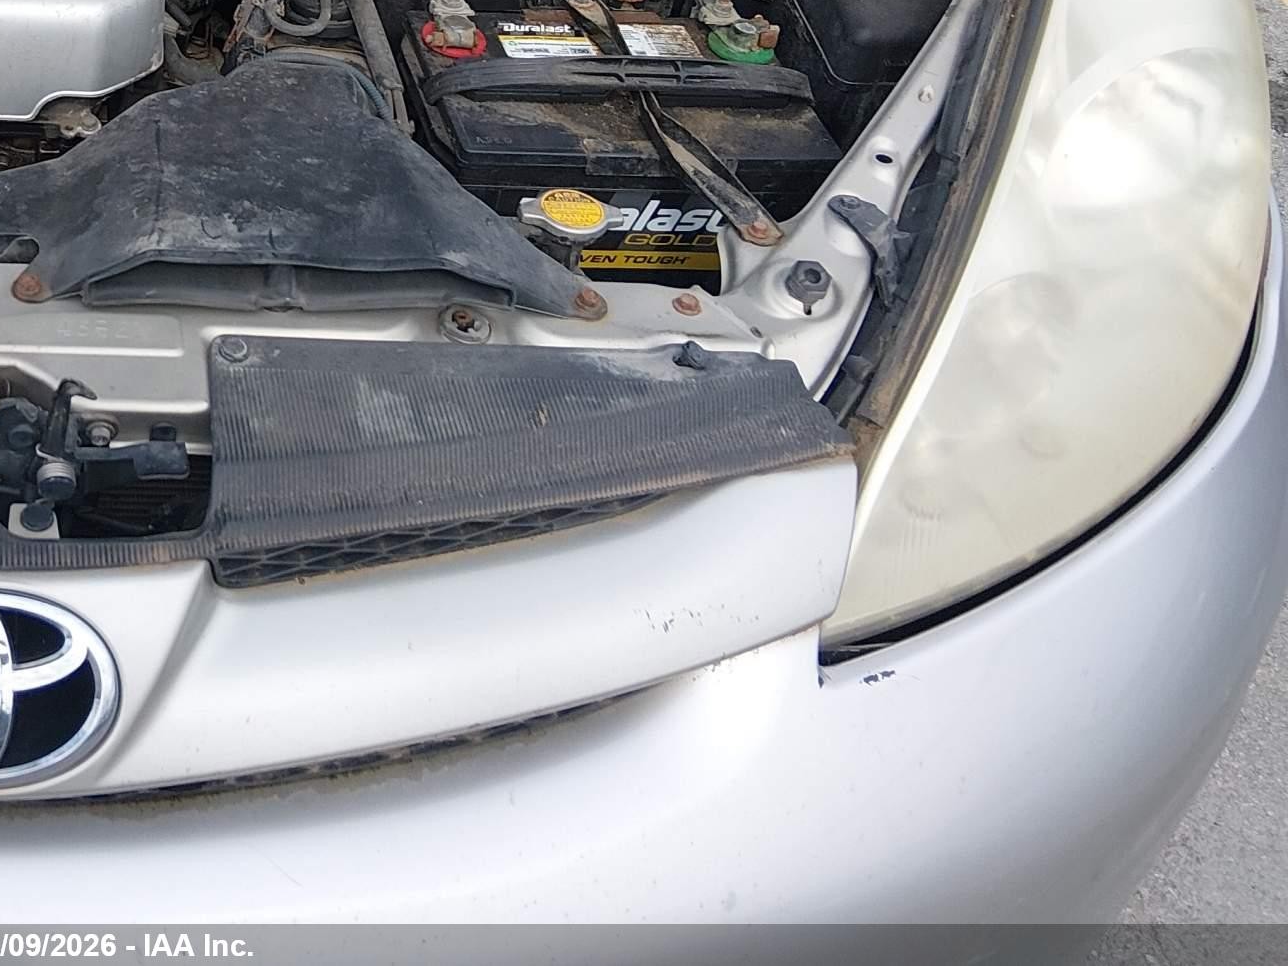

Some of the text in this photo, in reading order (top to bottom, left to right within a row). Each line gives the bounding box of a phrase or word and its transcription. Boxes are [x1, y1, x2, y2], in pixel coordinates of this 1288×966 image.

[498, 22, 573, 34] Duralast
[623, 234, 718, 246] GOLD
[580, 254, 687, 265] VEN TOUGH
